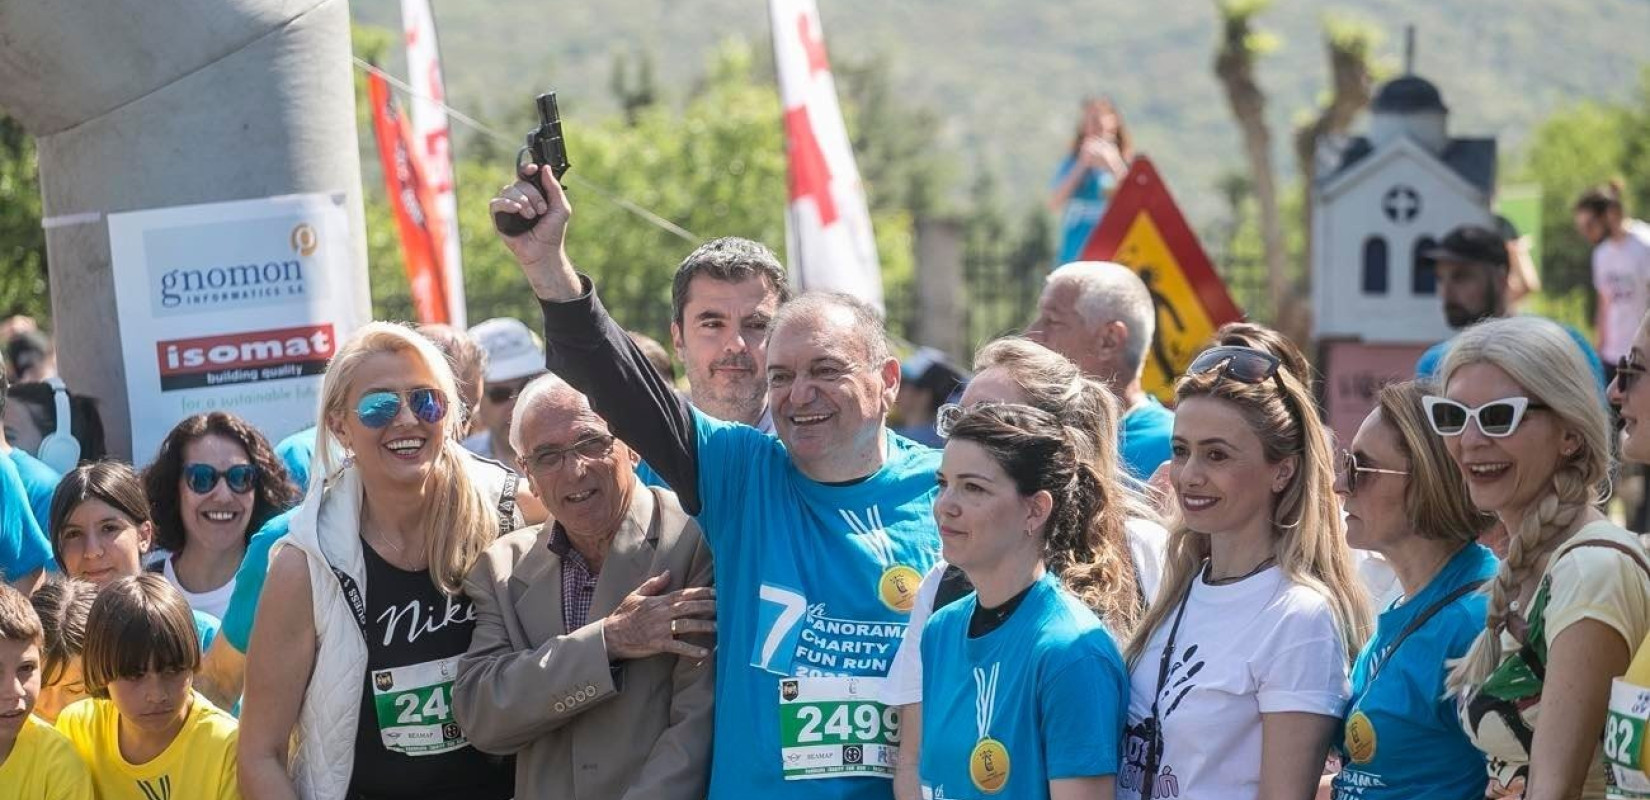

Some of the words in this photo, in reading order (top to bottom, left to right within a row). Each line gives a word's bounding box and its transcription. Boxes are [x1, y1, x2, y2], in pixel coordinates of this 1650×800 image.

[160, 258, 304, 309] gnomon
[186, 286, 280, 305] INFORMATICS
[166, 330, 331, 369] isomat
[206, 367, 258, 384] building
[261, 363, 303, 380] quality
[376, 593, 478, 647] Nike
[795, 646, 837, 667] FUN
[842, 658, 887, 672] RUN
[801, 628, 890, 654] CHARITY
[395, 686, 454, 724] 24
[796, 704, 902, 743] 2499
